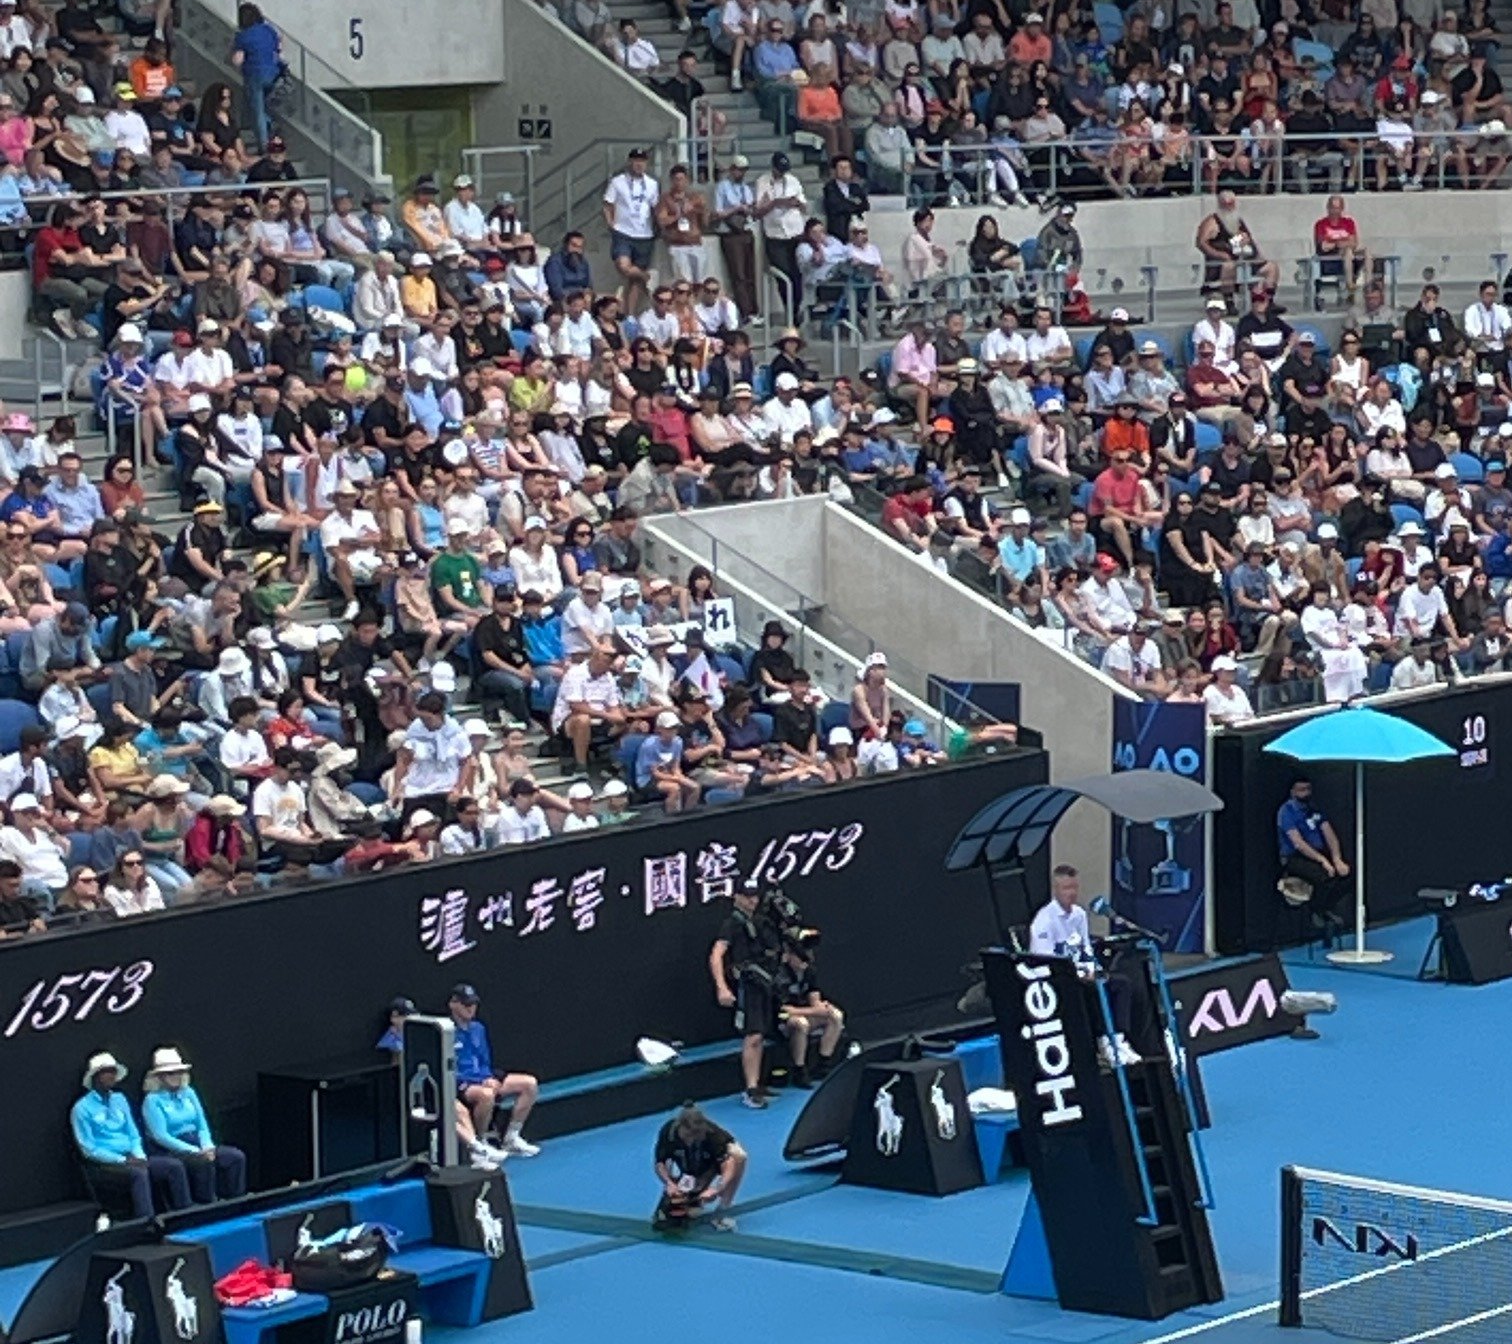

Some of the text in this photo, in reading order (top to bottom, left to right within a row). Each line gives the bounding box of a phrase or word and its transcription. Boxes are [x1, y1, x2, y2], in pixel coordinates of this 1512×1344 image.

[349, 18, 363, 60] 5
[1462, 716, 1486, 746] 10
[1150, 747, 1200, 775] AO
[4, 959, 154, 1037] 1573
[1016, 961, 1083, 1126] Haier
[336, 1299, 407, 1341] POLO
